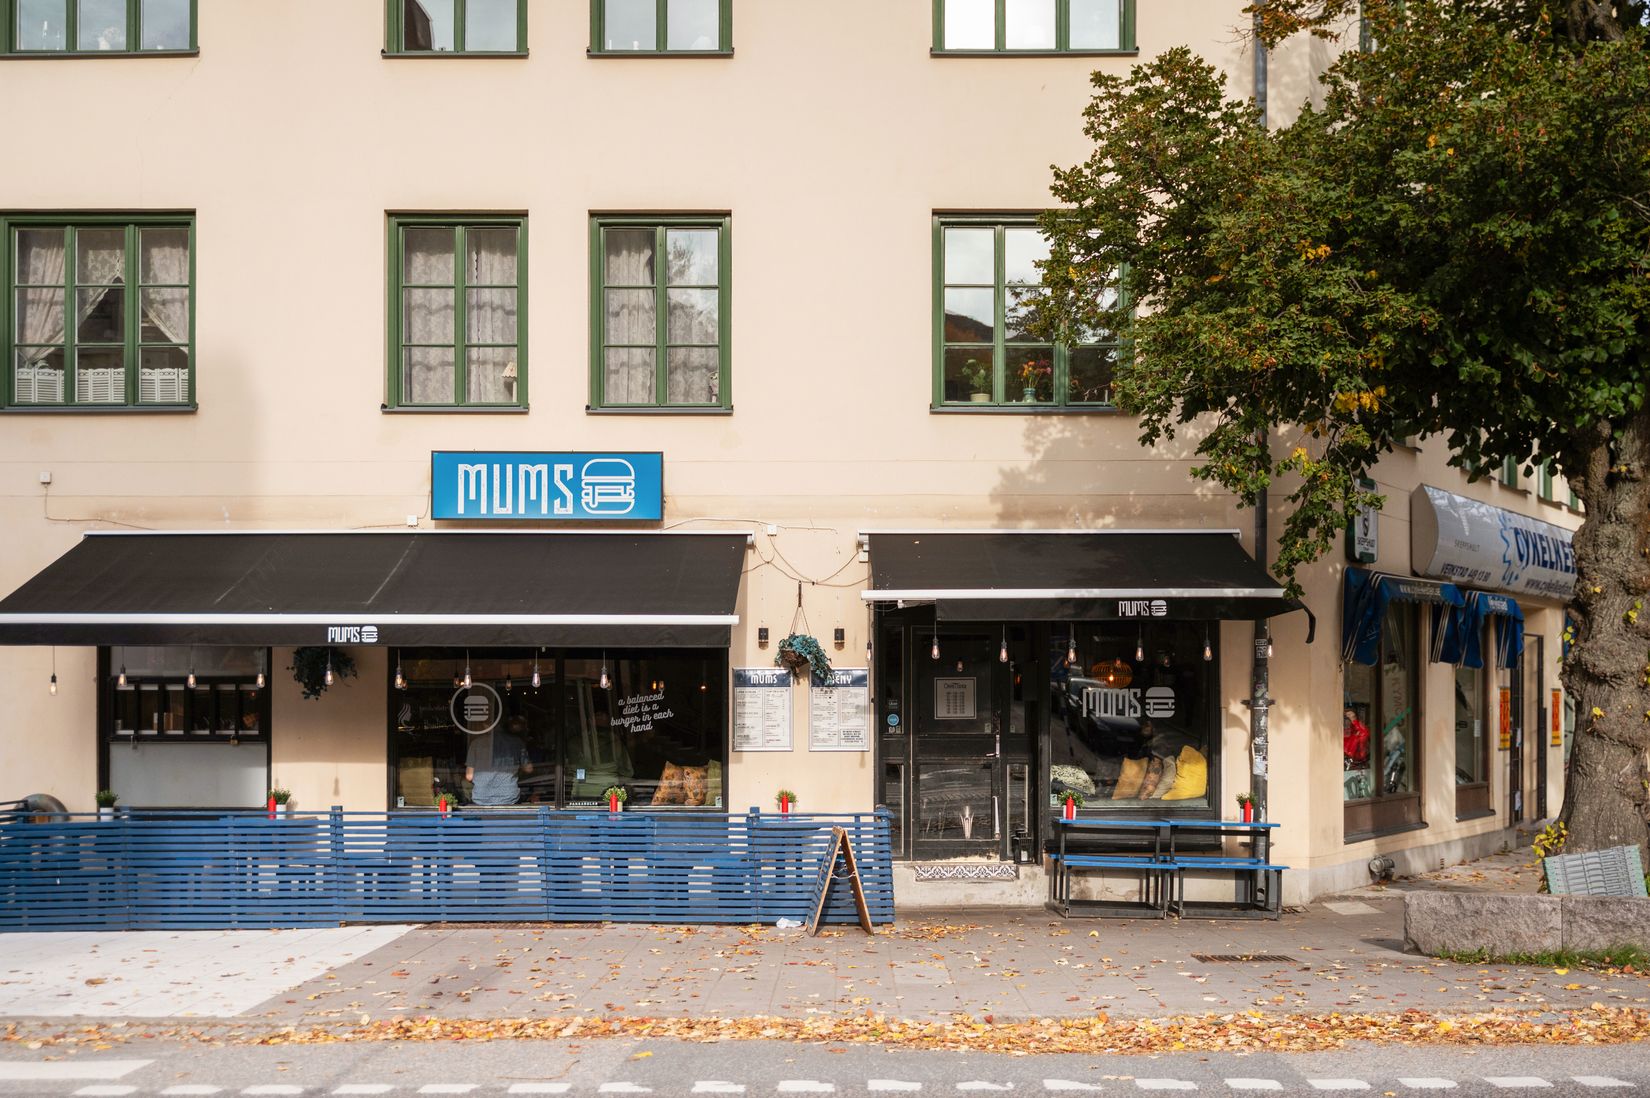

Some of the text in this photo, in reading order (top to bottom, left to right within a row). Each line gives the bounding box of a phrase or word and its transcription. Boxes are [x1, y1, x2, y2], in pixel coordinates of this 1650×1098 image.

[457, 463, 574, 514] MUMS
[1119, 601, 1149, 616] MUMS
[328, 626, 360, 642] MUMS
[750, 674, 778, 684] MUMS
[626, 689, 665, 705] balanced
[1083, 689, 1141, 717] MUMS
[622, 704, 641, 715] diet
[641, 703, 651, 712] is
[610, 708, 674, 728] burger in each
[630, 721, 653, 733] hand
